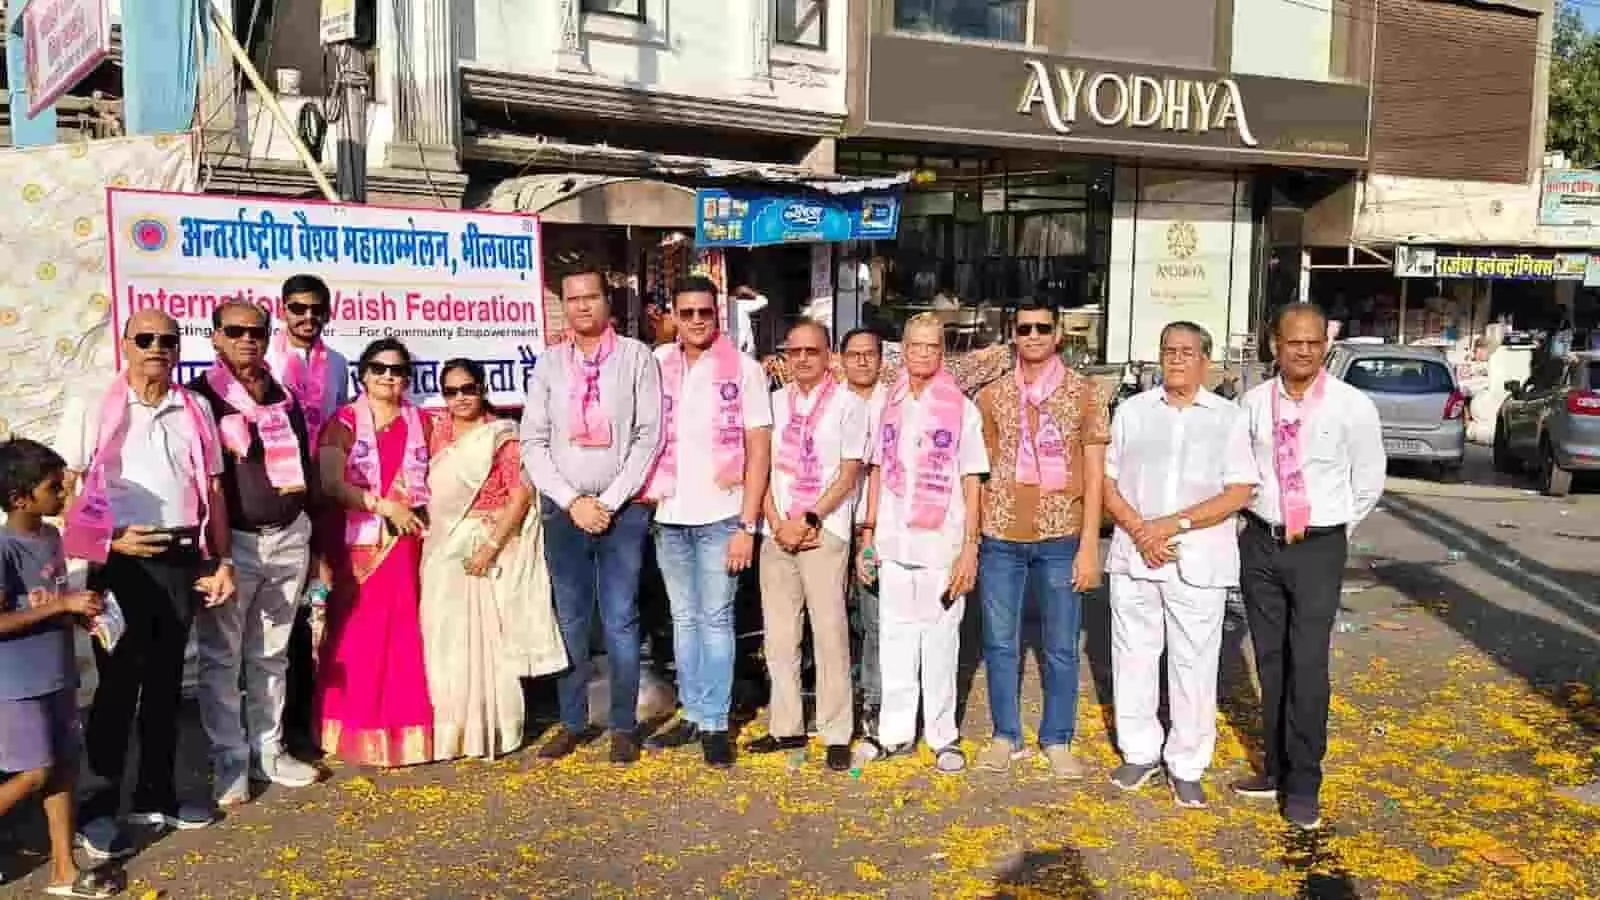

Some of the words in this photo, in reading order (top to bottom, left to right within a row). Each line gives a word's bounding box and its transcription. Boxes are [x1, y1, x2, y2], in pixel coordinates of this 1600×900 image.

[1016, 58, 1257, 146] AYODHYA
[180, 208, 294, 270] अन्तर्राष्ट्रीय
[294, 210, 338, 264] वैश्य
[461, 221, 535, 281] भीलवाड़ा
[405, 291, 537, 322] Federation
[383, 326, 454, 340] Community
[456, 326, 539, 339] Empowerment
